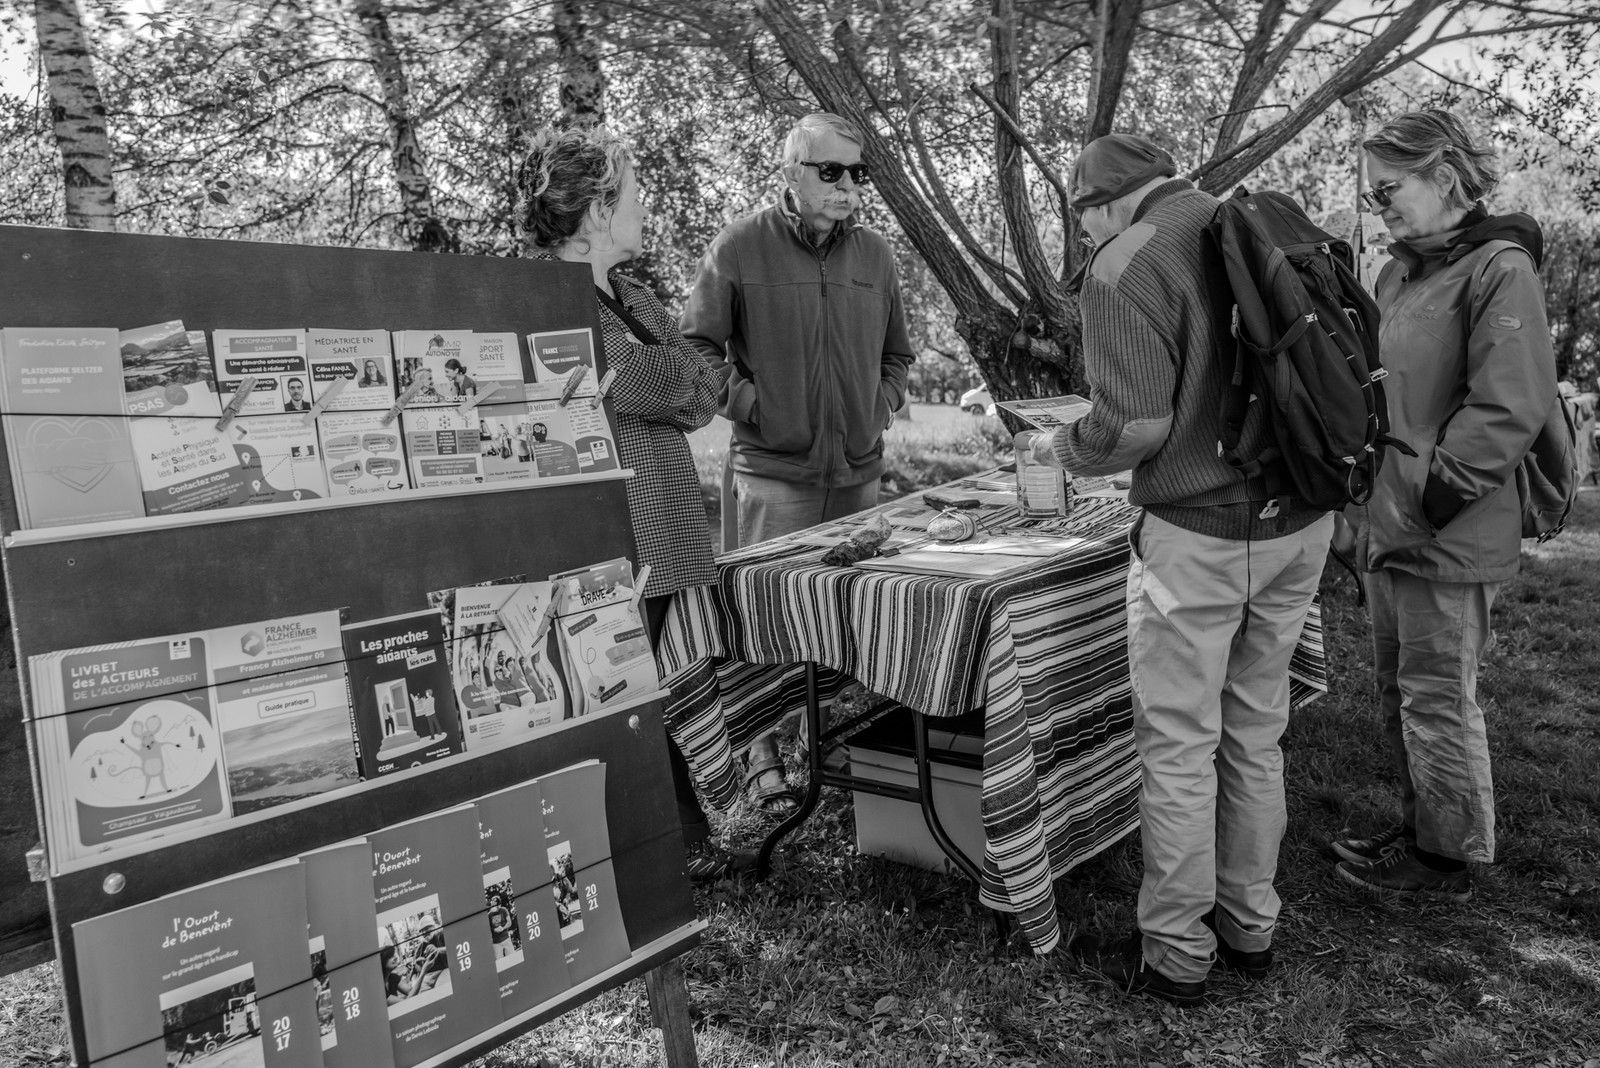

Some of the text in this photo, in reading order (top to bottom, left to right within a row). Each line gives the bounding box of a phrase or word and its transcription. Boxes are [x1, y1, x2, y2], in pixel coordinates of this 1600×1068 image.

[234, 337, 292, 345] ACCOMPAGNATEUR
[314, 336, 374, 346] MÉDIATRICE EN
[480, 344, 504, 353] SPORT
[332, 346, 358, 354] SANTÉ
[480, 353, 506, 362] SANTÉ
[542, 347, 559, 355] FRANCE
[21, 366, 103, 375] PLATEFORME SELTZER
[22, 377, 38, 385] DES
[129, 398, 165, 415] PSAS
[151, 437, 220, 462] Activité Physique
[161, 459, 171, 469] et
[171, 451, 197, 465] Santé
[173, 462, 198, 474] Alpes
[198, 457, 210, 467] du
[209, 452, 227, 464] Sud
[168, 472, 231, 496] Contactez nous
[580, 588, 606, 606] DRAYE
[460, 603, 491, 612] BIENVENUE
[265, 622, 301, 635] FRANCE
[266, 627, 317, 643] ALZHEIMER
[360, 630, 429, 653] Les proches
[240, 651, 325, 673] France Alzheimer 05
[376, 646, 418, 665] aidants
[71, 661, 118, 678] LIVRET
[72, 667, 160, 690] des ACTEURS
[73, 672, 199, 701] DE L'ACCOMPAGNEMENT
[242, 687, 251, 696] et
[252, 681, 284, 694] maladies
[285, 673, 328, 688] apparentées
[265, 697, 310, 712] Guide pratique
[108, 816, 147, 831] Champsaur
[154, 803, 197, 819] Valgaudemar
[379, 853, 422, 875] Benevènt
[408, 882, 427, 892] handicap
[585, 883, 598, 898] 20
[588, 897, 599, 912] 21
[526, 911, 539, 927] 20
[162, 917, 233, 949] de Benevènt
[528, 926, 541, 941] 20
[180, 946, 221, 966] Un autre regard
[456, 941, 471, 957] 20
[162, 973, 172, 981] sur
[178, 965, 194, 978] grand
[215, 949, 240, 963] handicap
[458, 957, 472, 973] 19
[342, 987, 360, 1005] 20
[344, 1003, 361, 1021] 18
[272, 1016, 291, 1035] 20
[415, 1013, 447, 1031] photographique
[275, 1033, 291, 1052] 17
